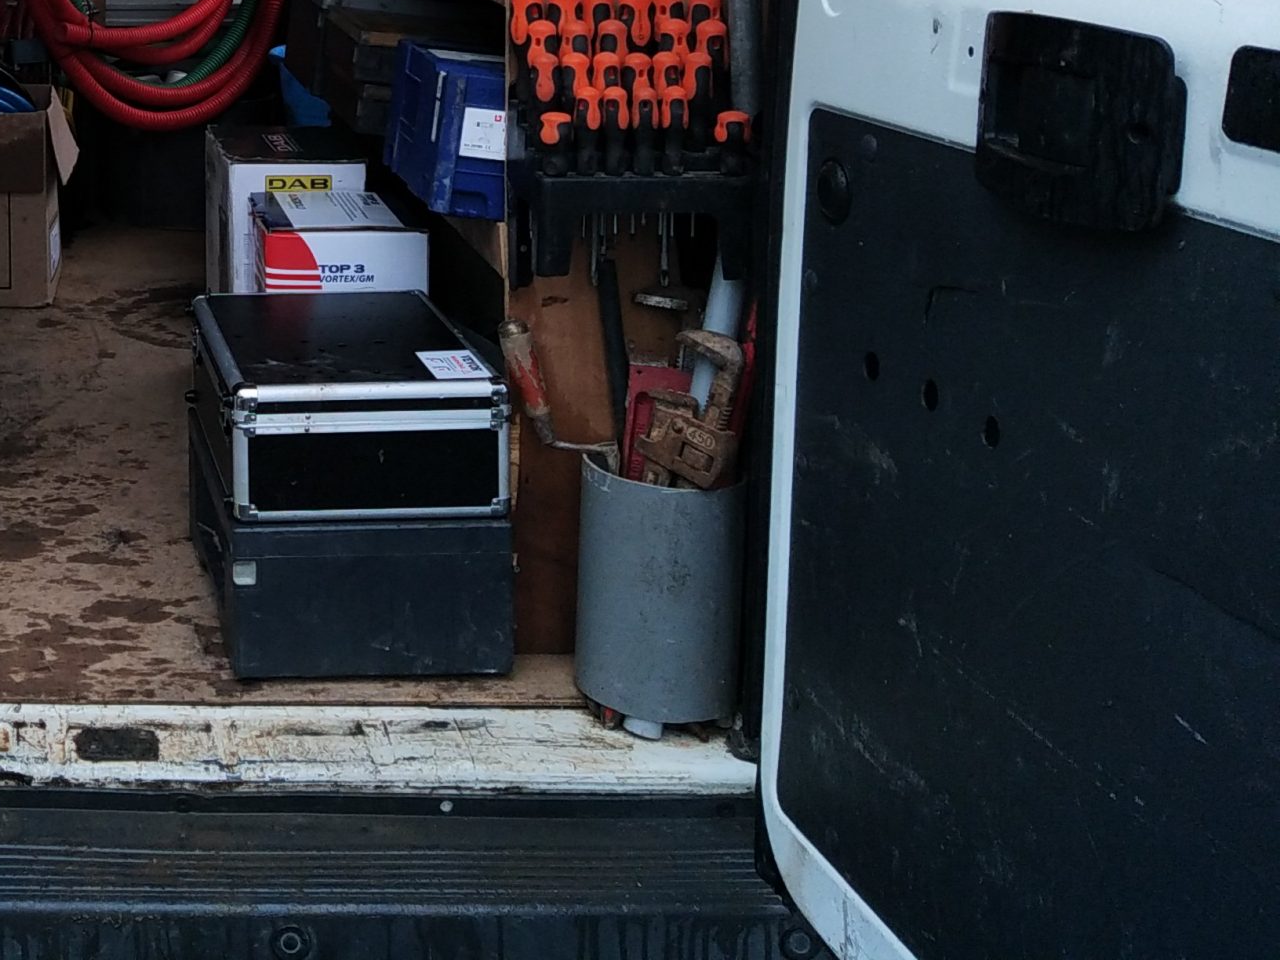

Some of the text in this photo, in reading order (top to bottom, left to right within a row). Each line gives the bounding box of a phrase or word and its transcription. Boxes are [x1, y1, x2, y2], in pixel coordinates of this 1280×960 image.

[268, 178, 329, 190] DAB
[318, 264, 365, 274] TOP 3
[319, 274, 375, 283] VORTEX/GM
[688, 430, 714, 448] 450
